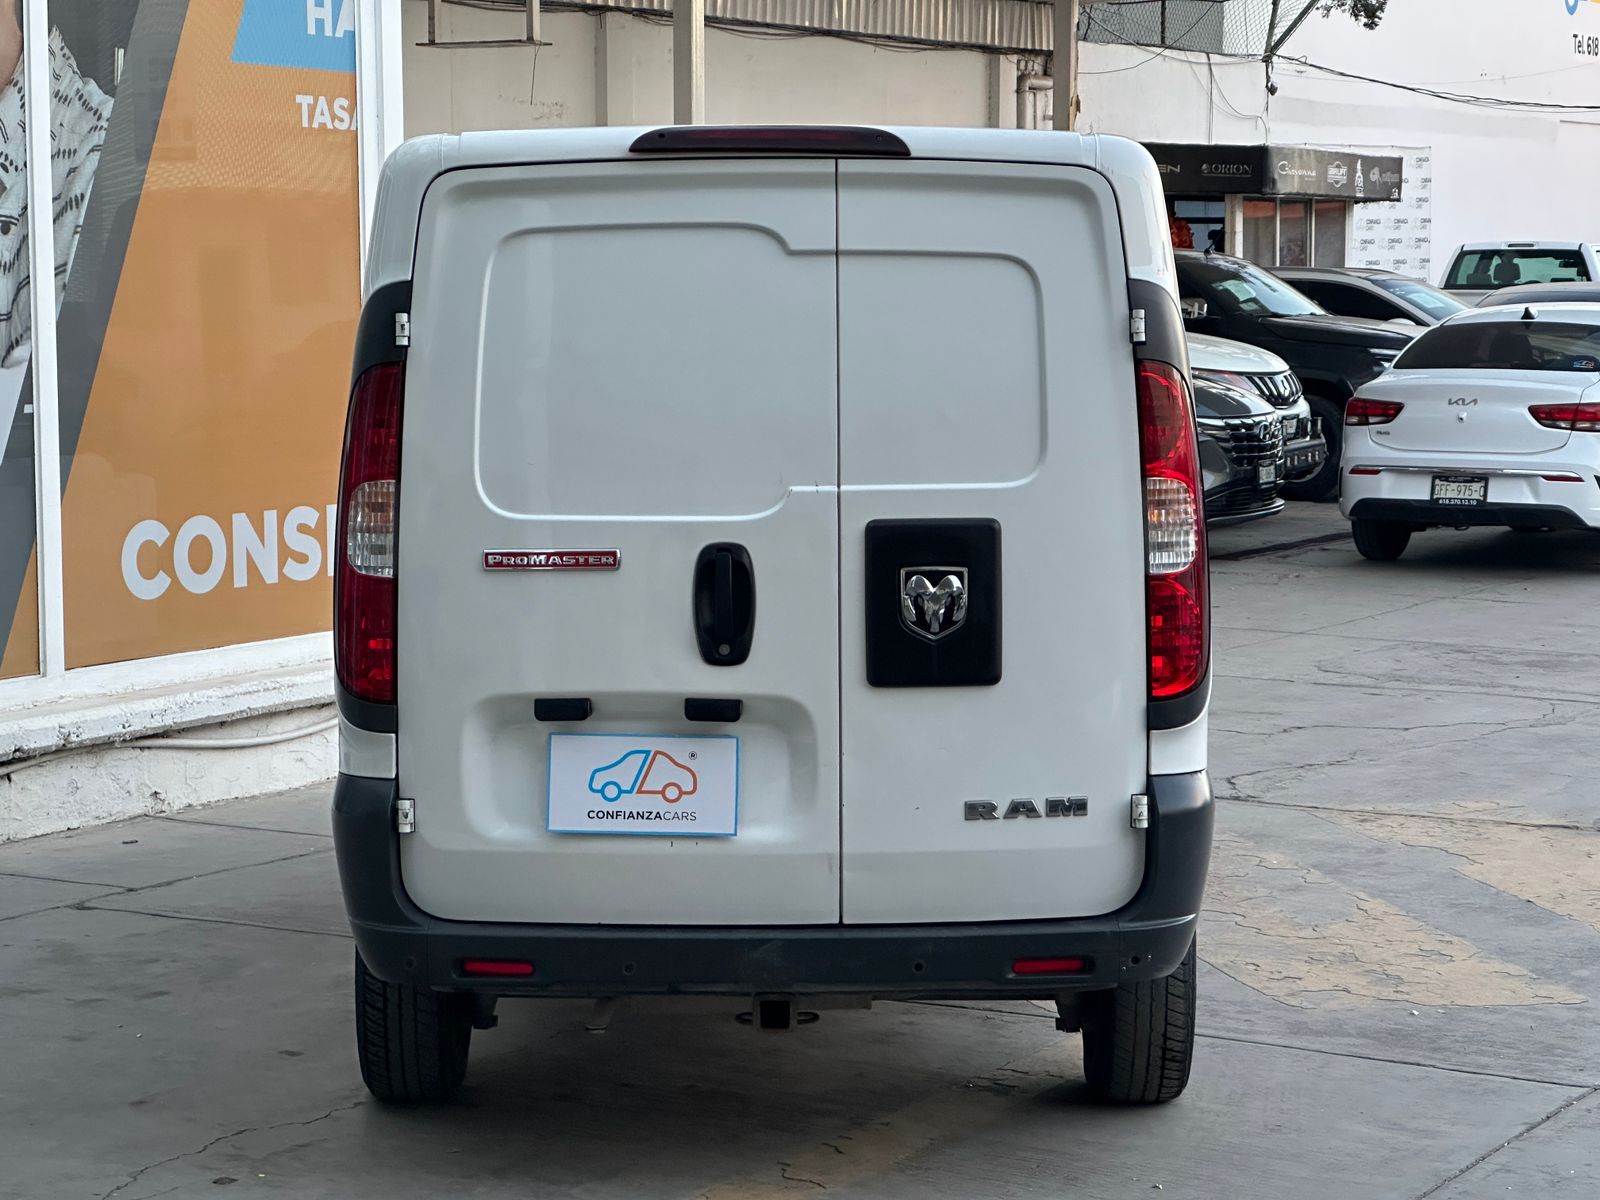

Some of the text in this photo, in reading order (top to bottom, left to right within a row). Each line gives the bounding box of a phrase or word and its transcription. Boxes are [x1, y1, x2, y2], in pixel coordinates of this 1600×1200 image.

[1573, 33, 1599, 57] Tel. 618
[1212, 163, 1252, 174] ORION
[587, 810, 697, 821] CONFIANZACARS
[964, 796, 1088, 821] RAM
